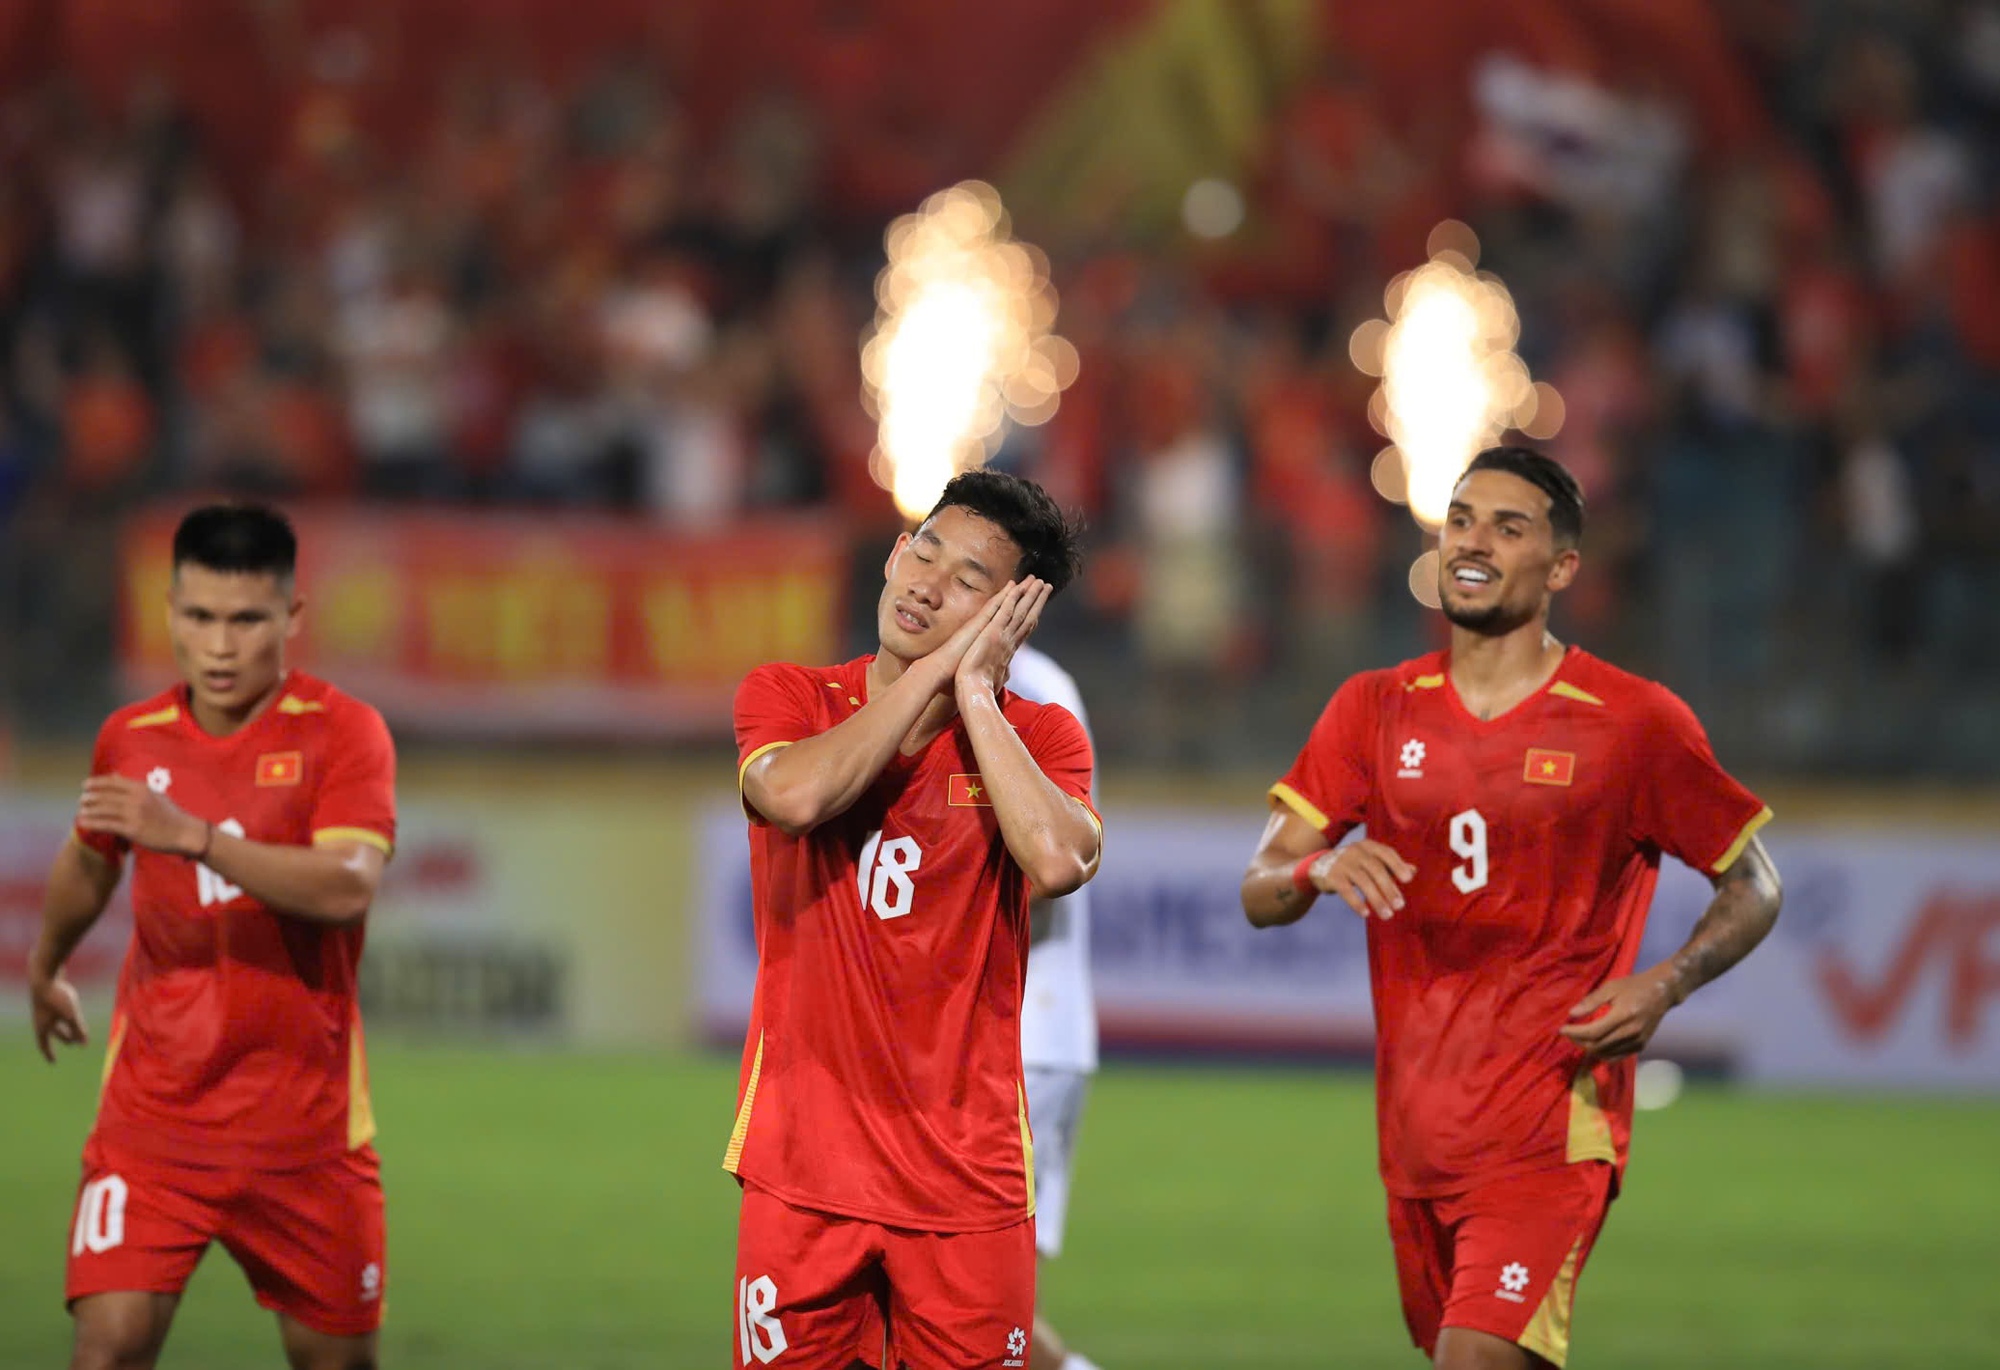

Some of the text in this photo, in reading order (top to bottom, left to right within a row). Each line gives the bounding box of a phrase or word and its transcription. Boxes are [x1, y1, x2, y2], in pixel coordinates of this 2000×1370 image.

[857, 829, 923, 920] 18
[1449, 808, 1489, 895] 9
[72, 1174, 128, 1257] 10
[739, 1274, 789, 1368] 18
